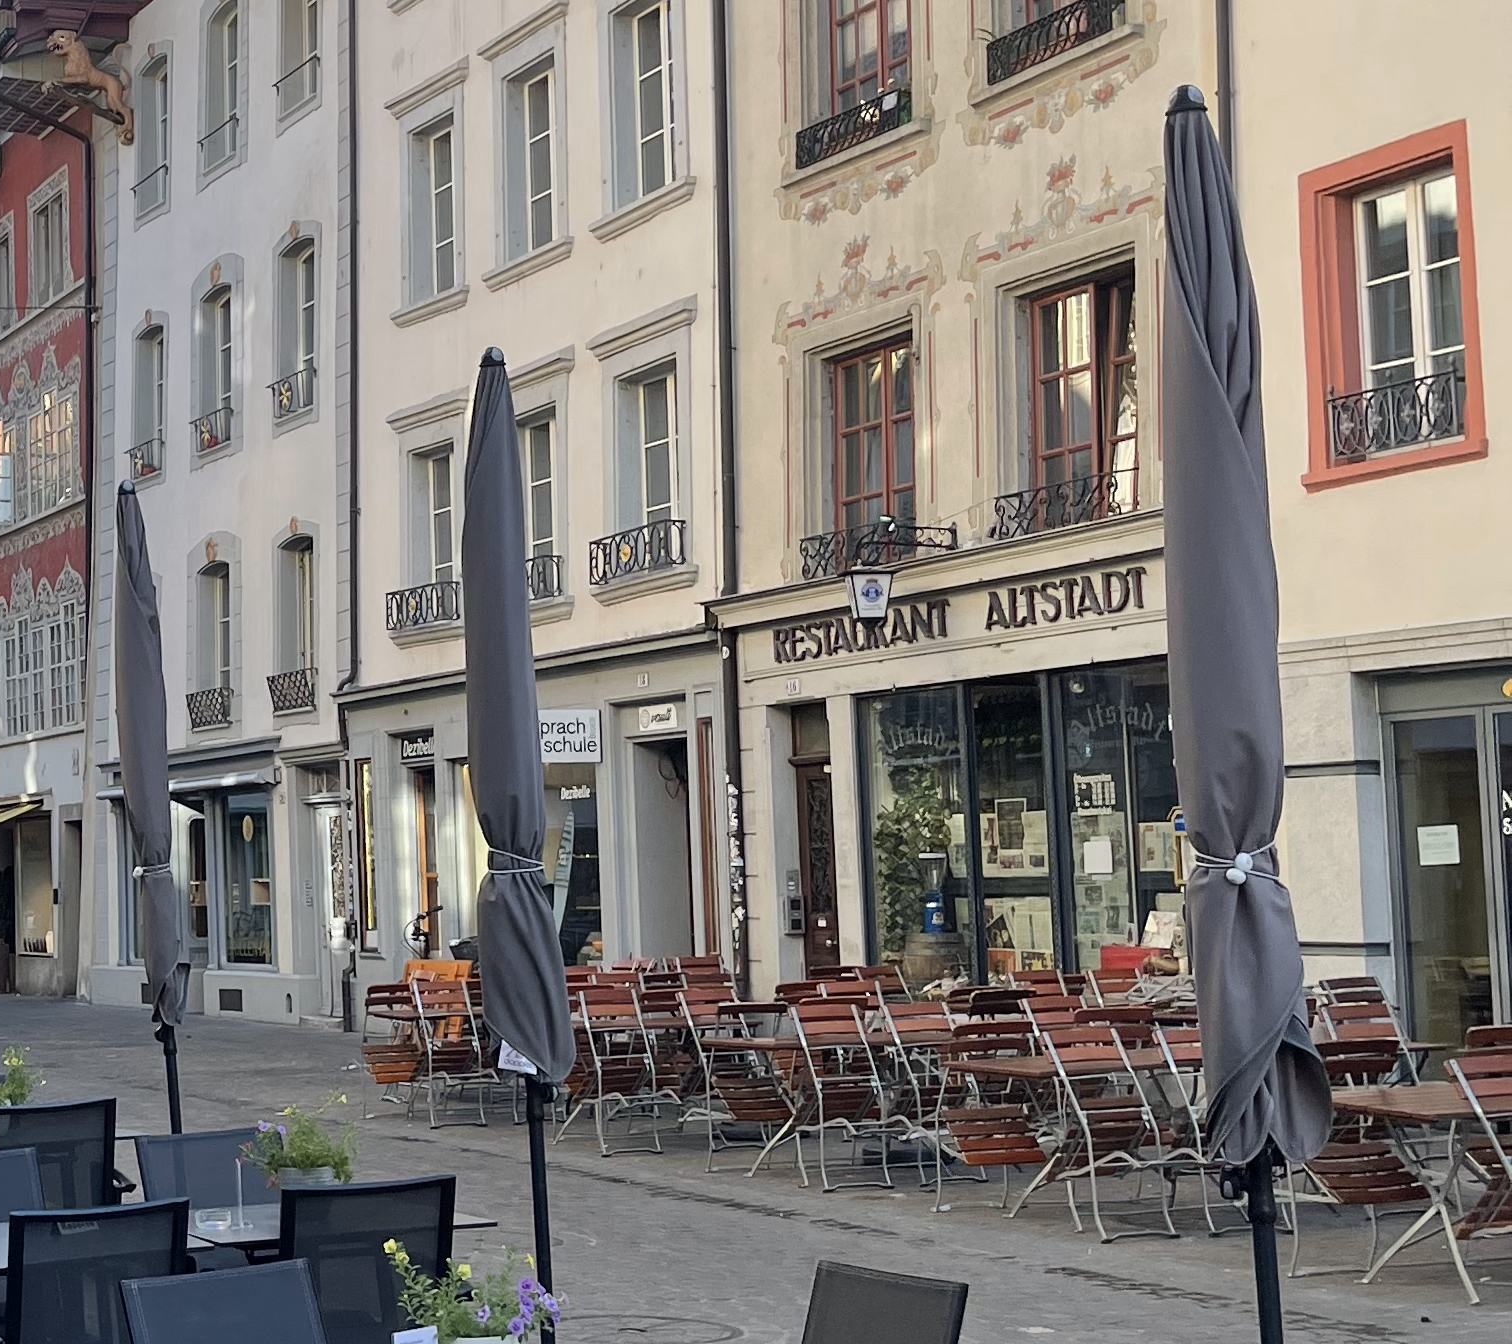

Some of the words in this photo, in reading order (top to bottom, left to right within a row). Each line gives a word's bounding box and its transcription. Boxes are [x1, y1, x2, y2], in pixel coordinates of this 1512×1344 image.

[985, 566, 1148, 631] ALTSTADT
[539, 717, 586, 739] prach
[543, 736, 598, 753] schule
